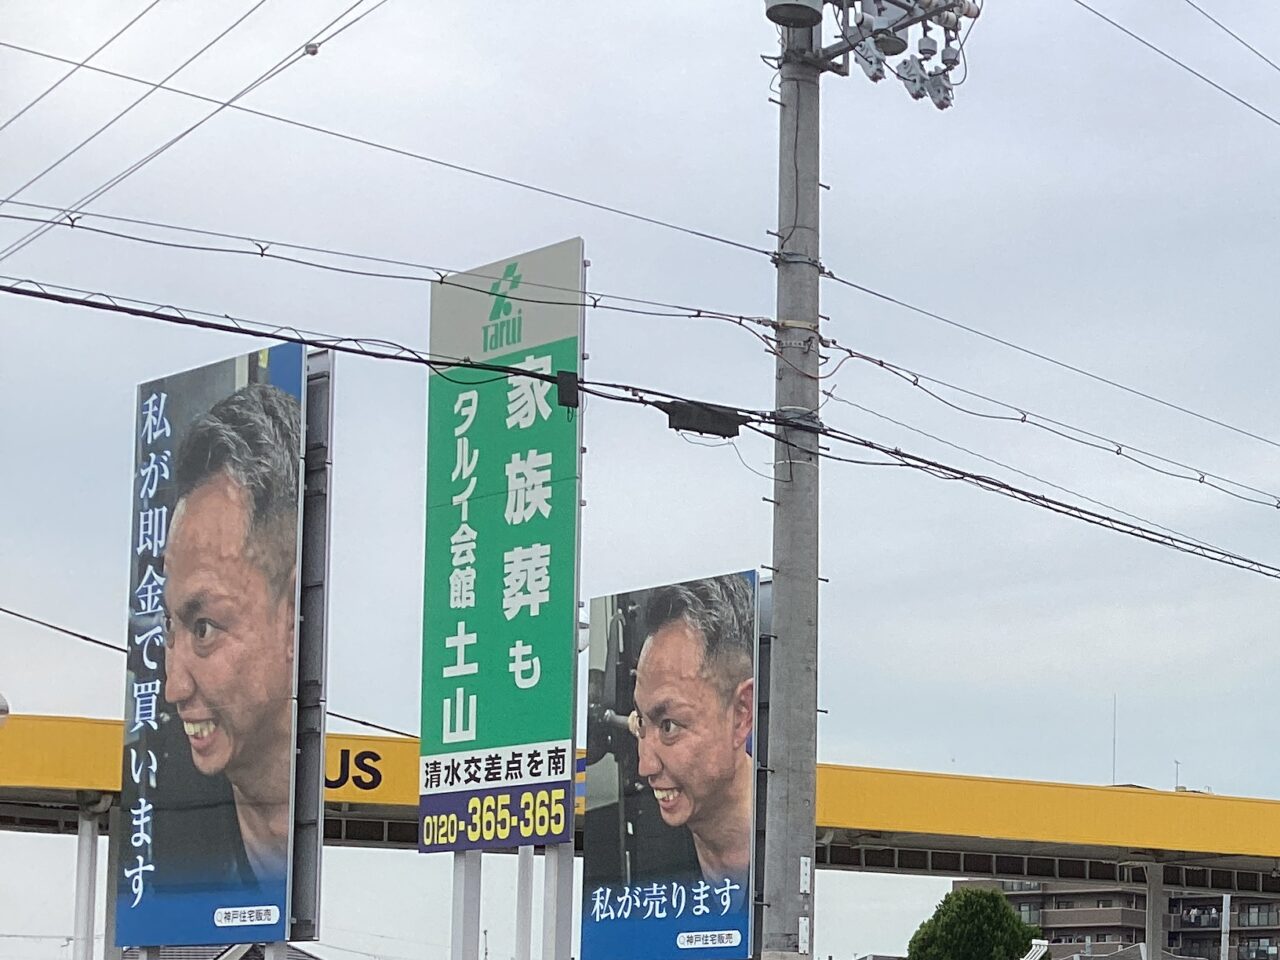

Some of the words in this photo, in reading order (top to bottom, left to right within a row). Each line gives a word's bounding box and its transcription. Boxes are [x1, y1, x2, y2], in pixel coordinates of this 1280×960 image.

[481, 308, 522, 353] Tarui
[502, 354, 554, 689] 家族葬も
[123, 391, 172, 909] 私が即金で買います
[424, 745, 566, 789] 清水交差点を南
[422, 787, 566, 847] 0120-365-365
[590, 877, 741, 923] 私が売ります
